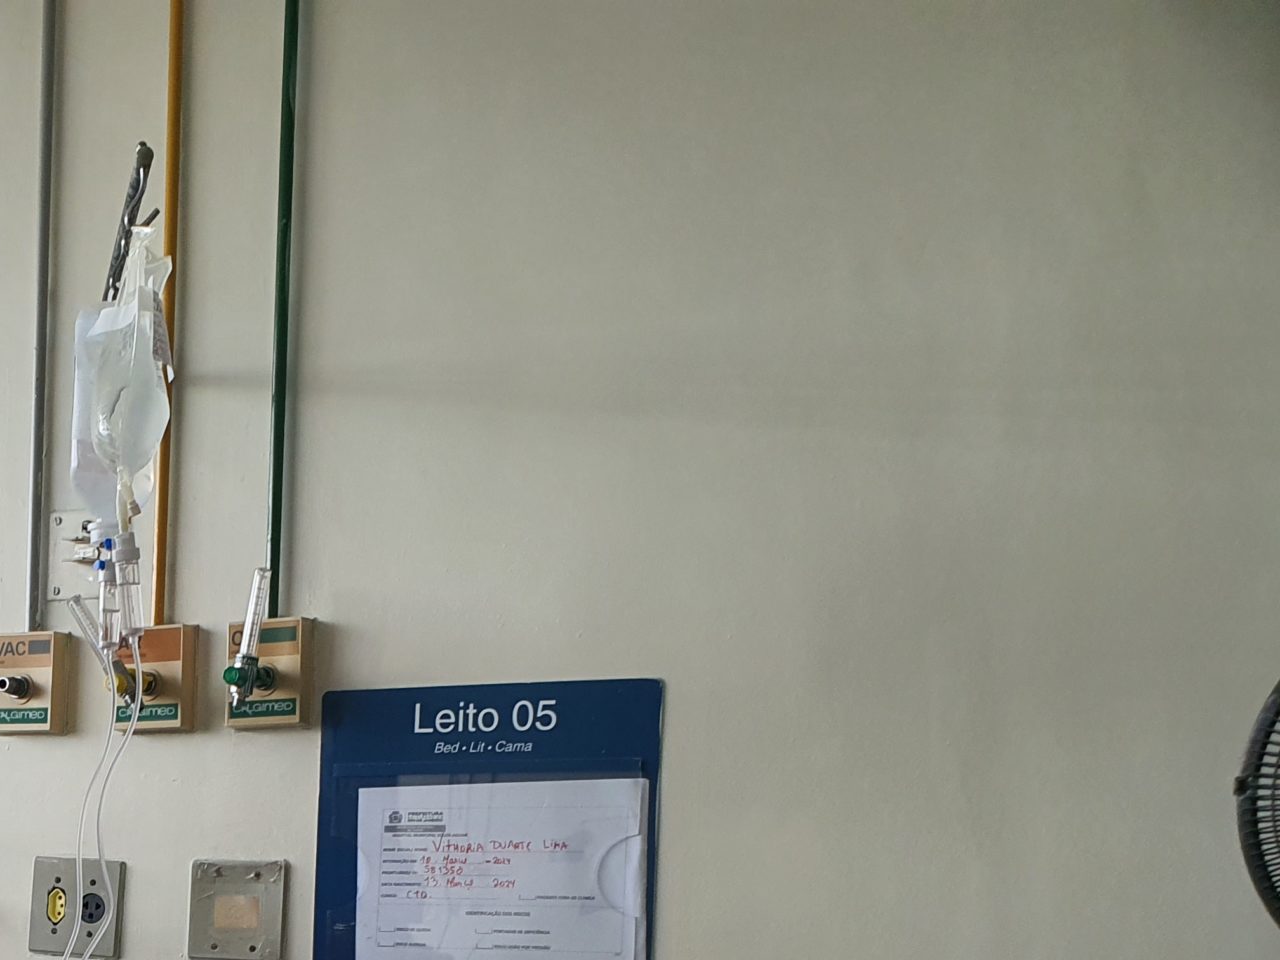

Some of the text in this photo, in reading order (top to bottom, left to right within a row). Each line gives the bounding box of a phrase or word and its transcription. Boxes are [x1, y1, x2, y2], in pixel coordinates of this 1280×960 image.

[414, 699, 557, 733] Leito 05
[434, 740, 533, 754] Bed Lit Cama
